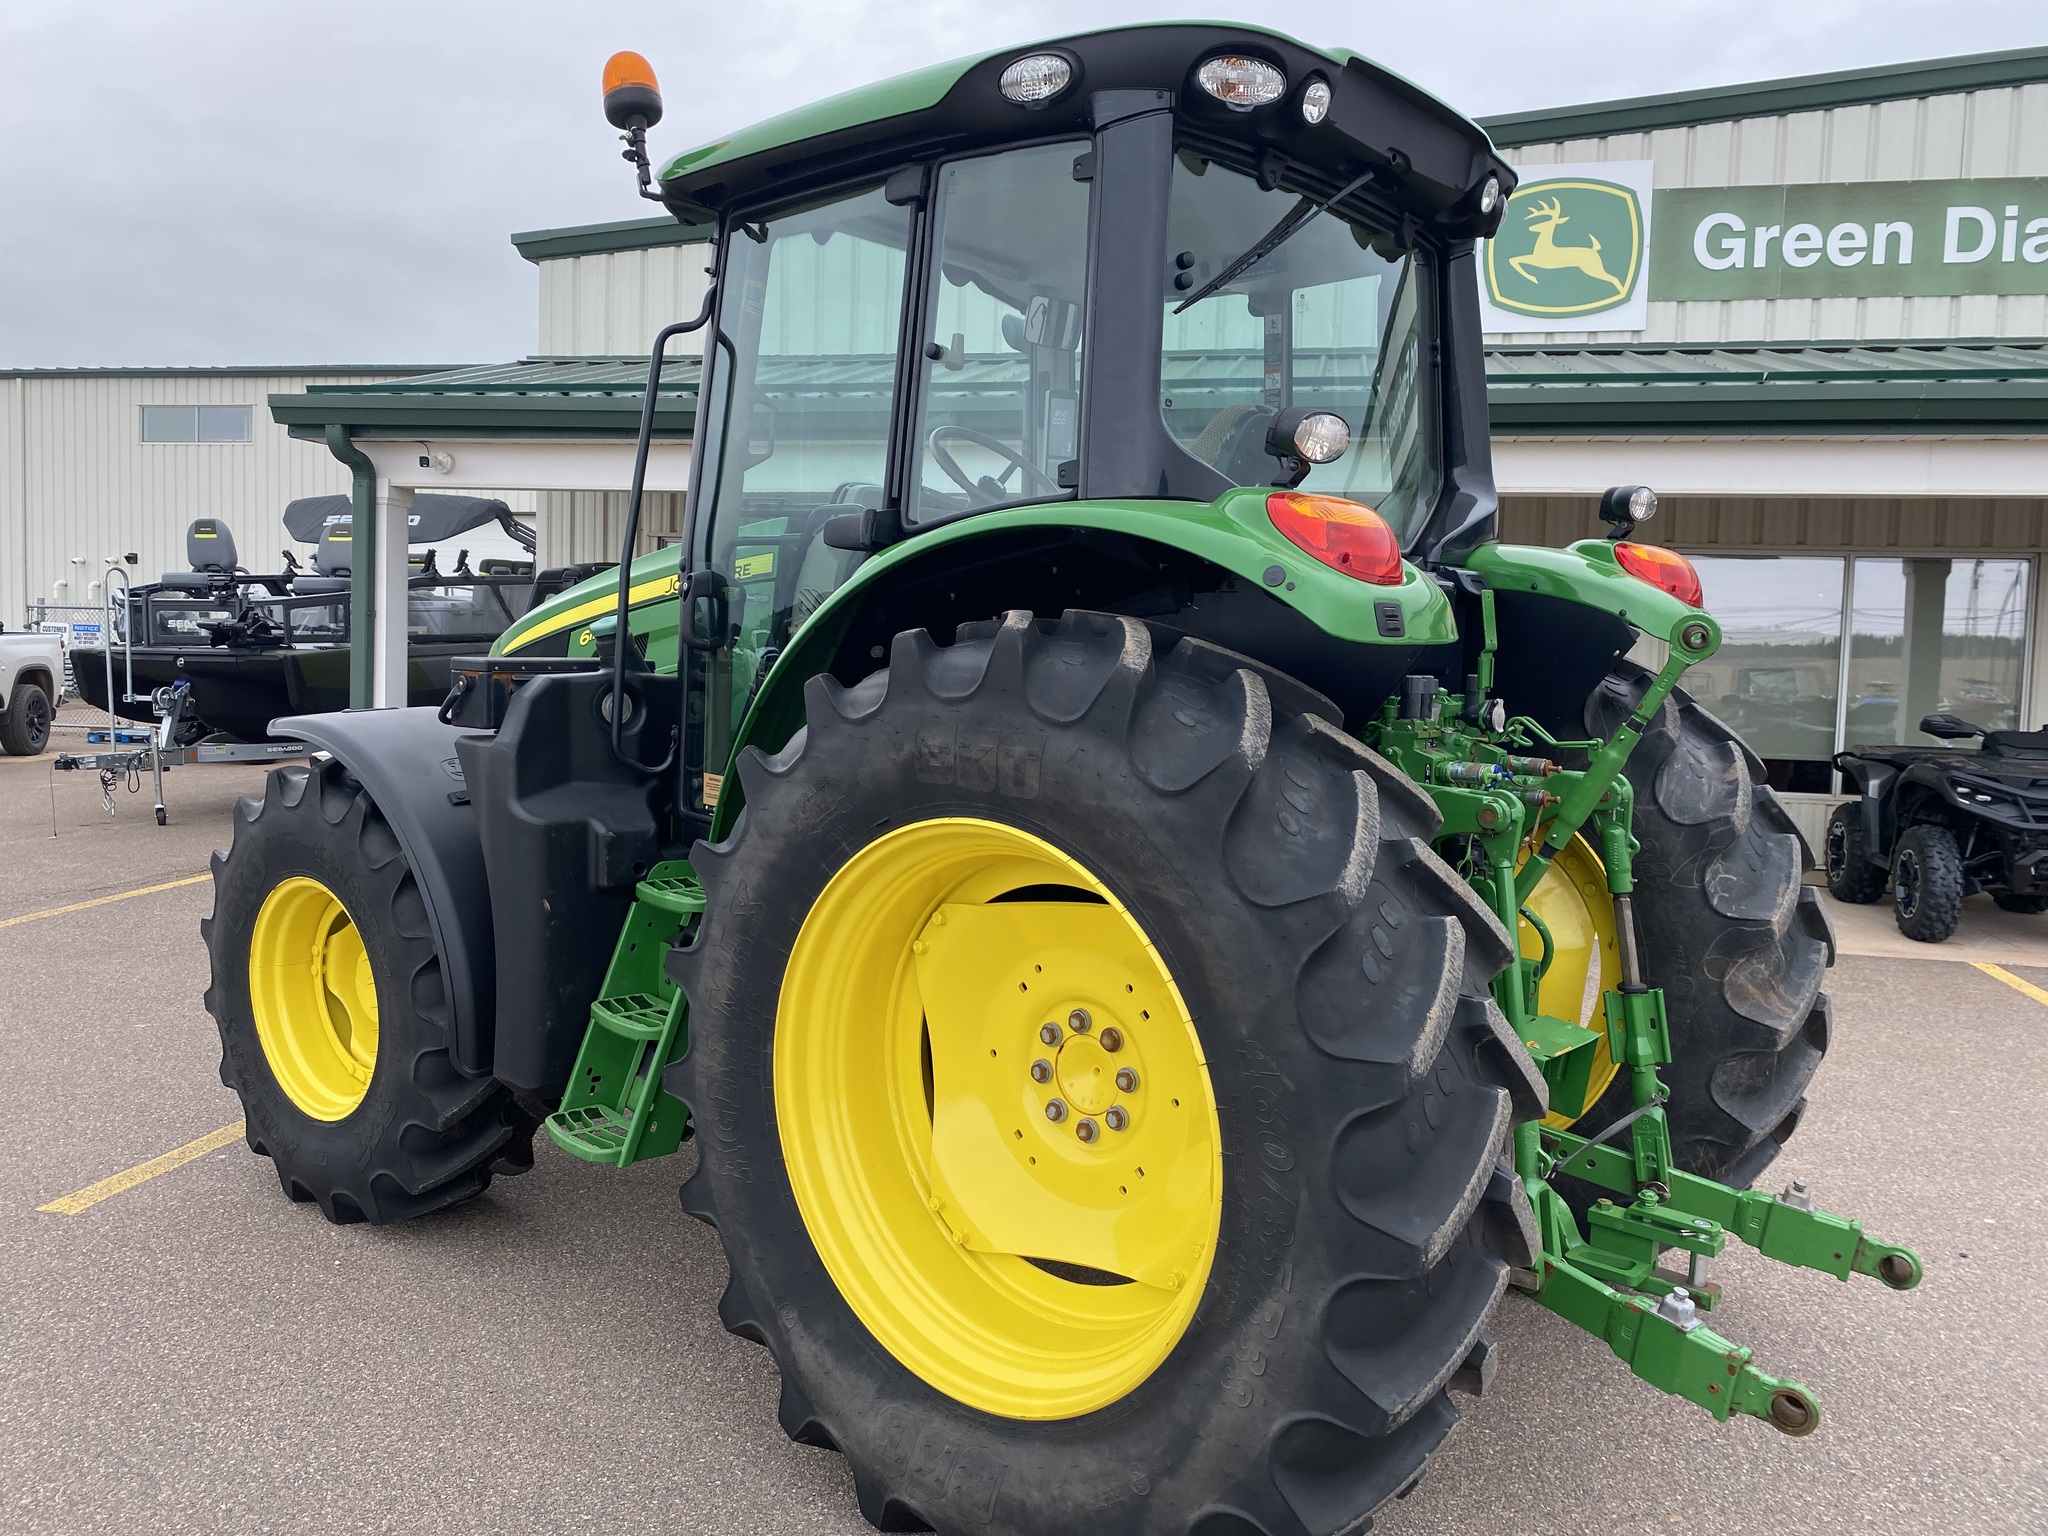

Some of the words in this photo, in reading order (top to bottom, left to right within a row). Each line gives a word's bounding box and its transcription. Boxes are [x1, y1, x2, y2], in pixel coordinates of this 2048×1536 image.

[1693, 212, 1914, 271] Green
[1943, 205, 2048, 264] Dia
[42, 625, 67, 633] CUSTOMER
